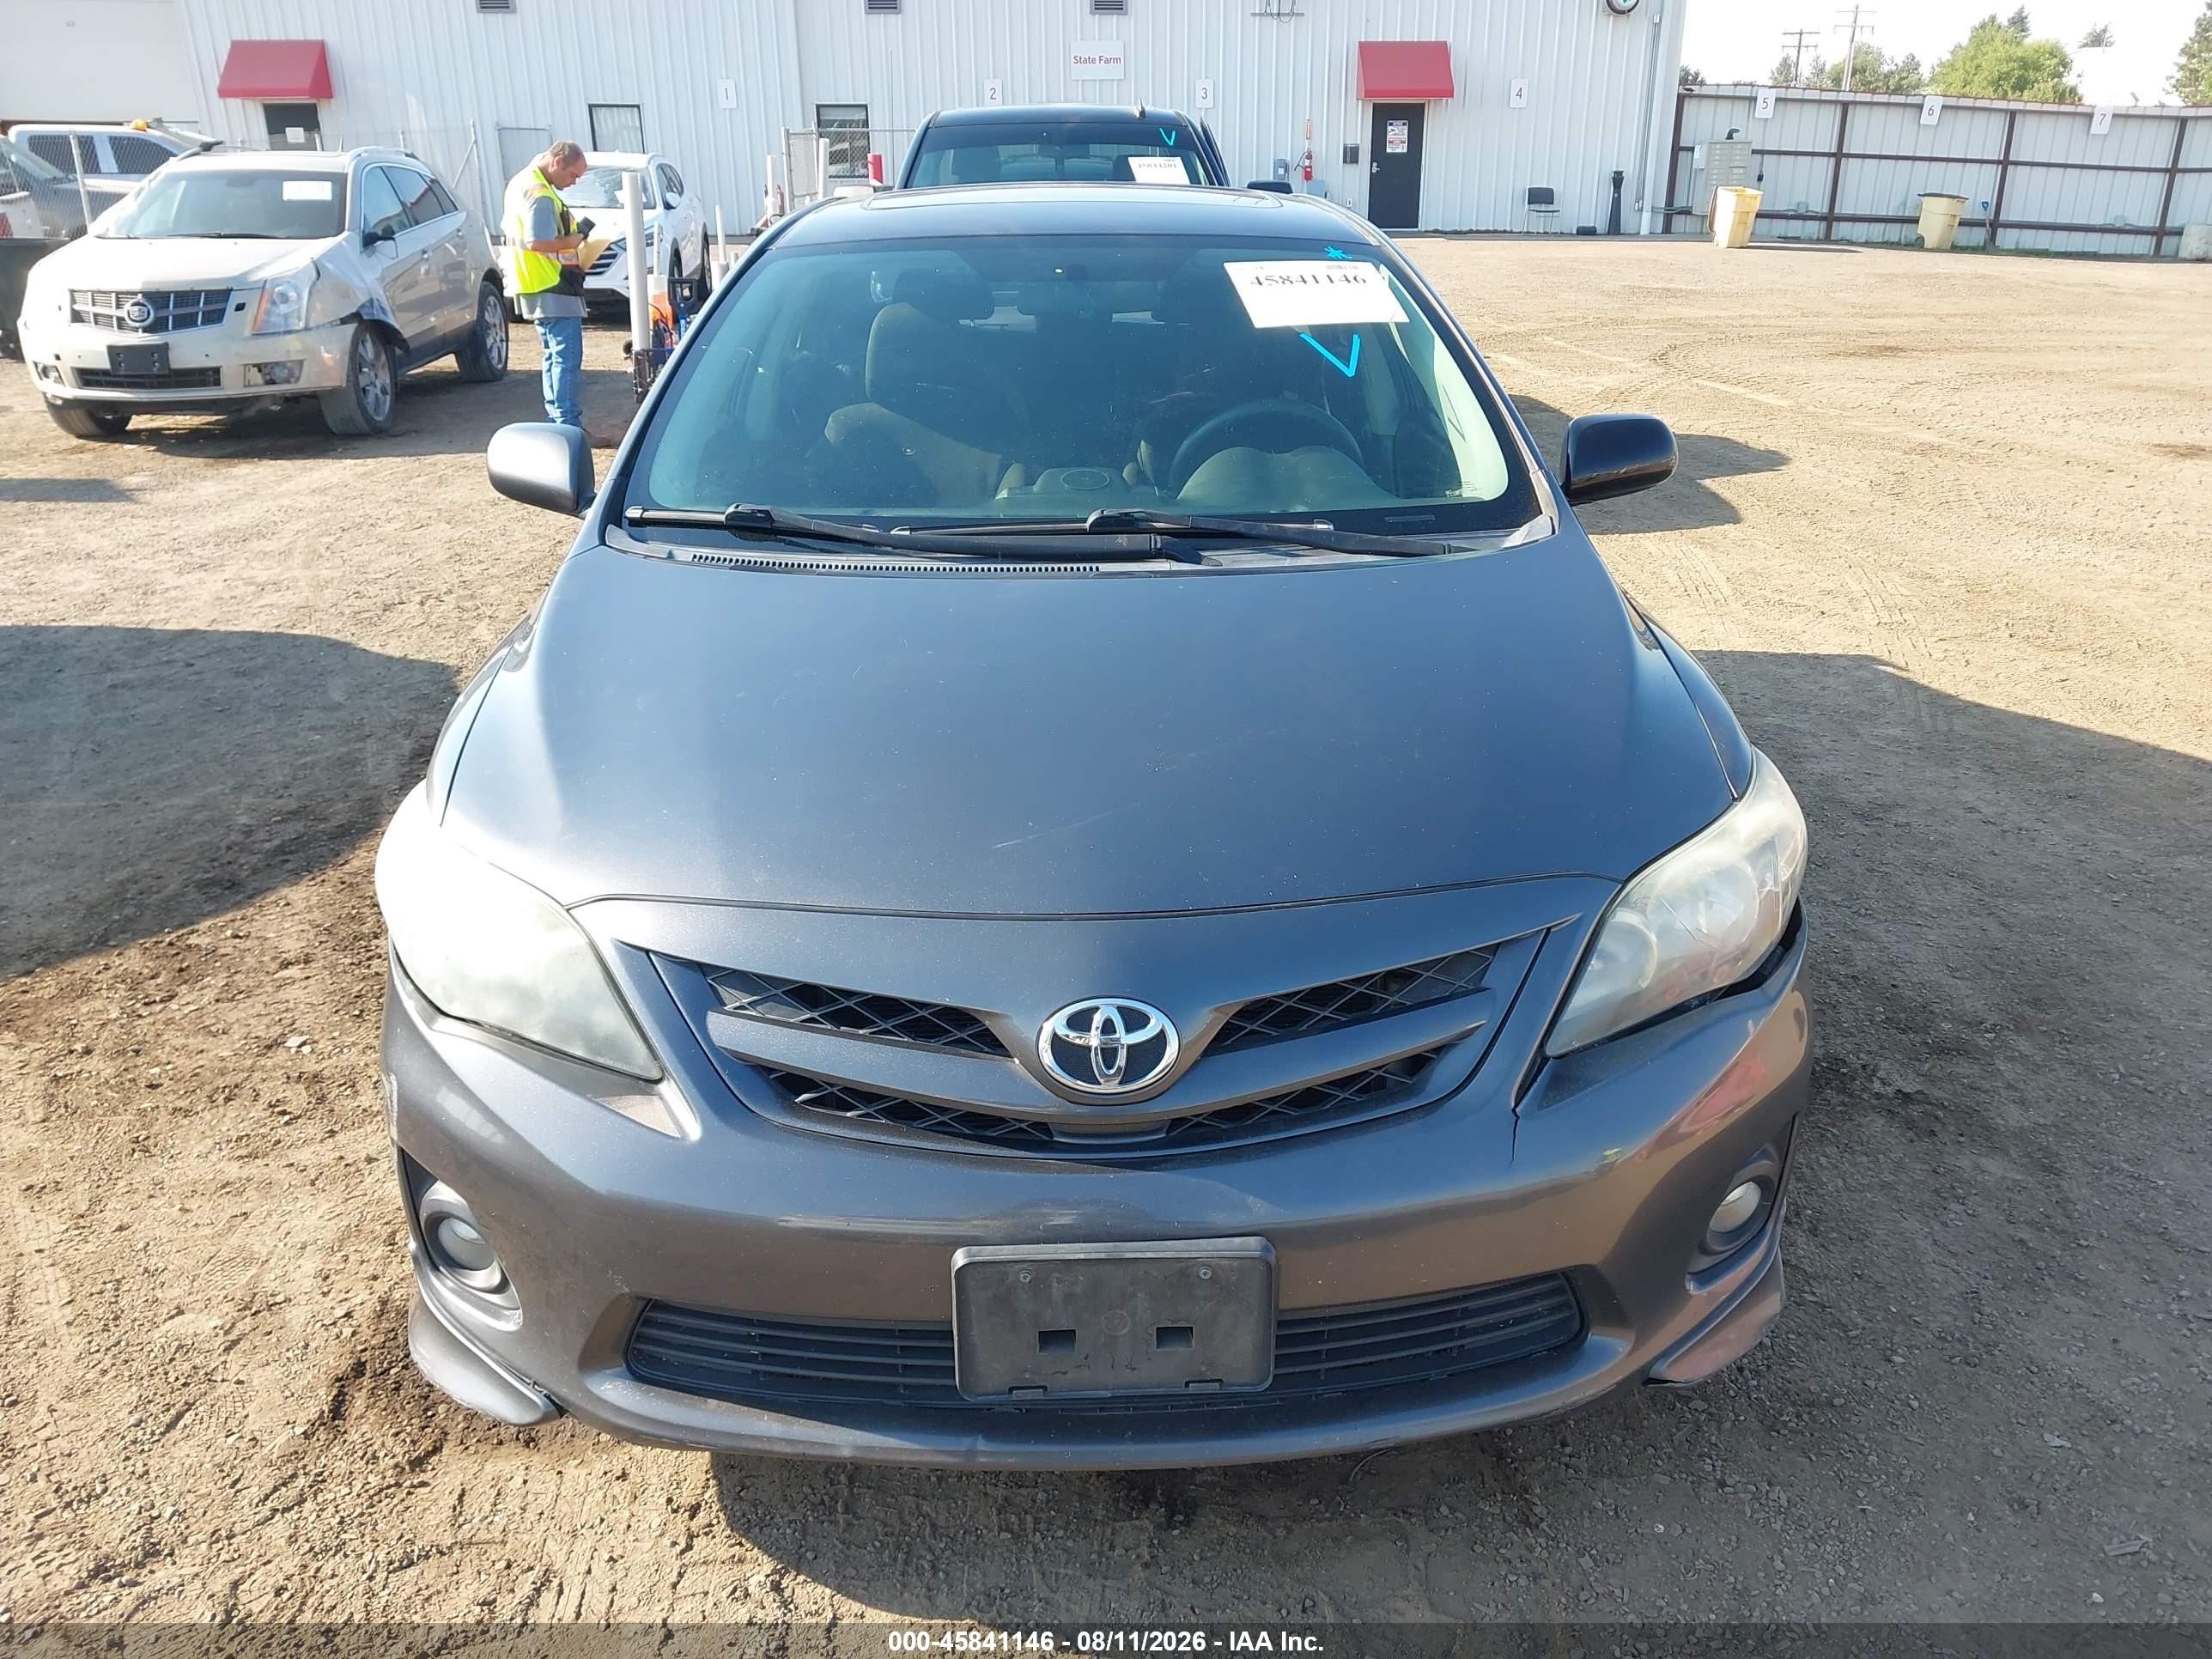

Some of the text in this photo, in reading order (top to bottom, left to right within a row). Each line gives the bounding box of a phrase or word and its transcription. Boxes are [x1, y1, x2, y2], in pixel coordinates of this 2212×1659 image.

[1073, 55, 1121, 64] State Farm
[724, 88, 729, 100] 1
[990, 88, 997, 100] 2
[1201, 87, 1207, 100] 3
[1516, 87, 1522, 100] 4
[1762, 97, 1769, 110] 5
[1928, 105, 1935, 117] 6
[2100, 113, 2106, 126] 7
[1250, 274, 1367, 287] 45841146
